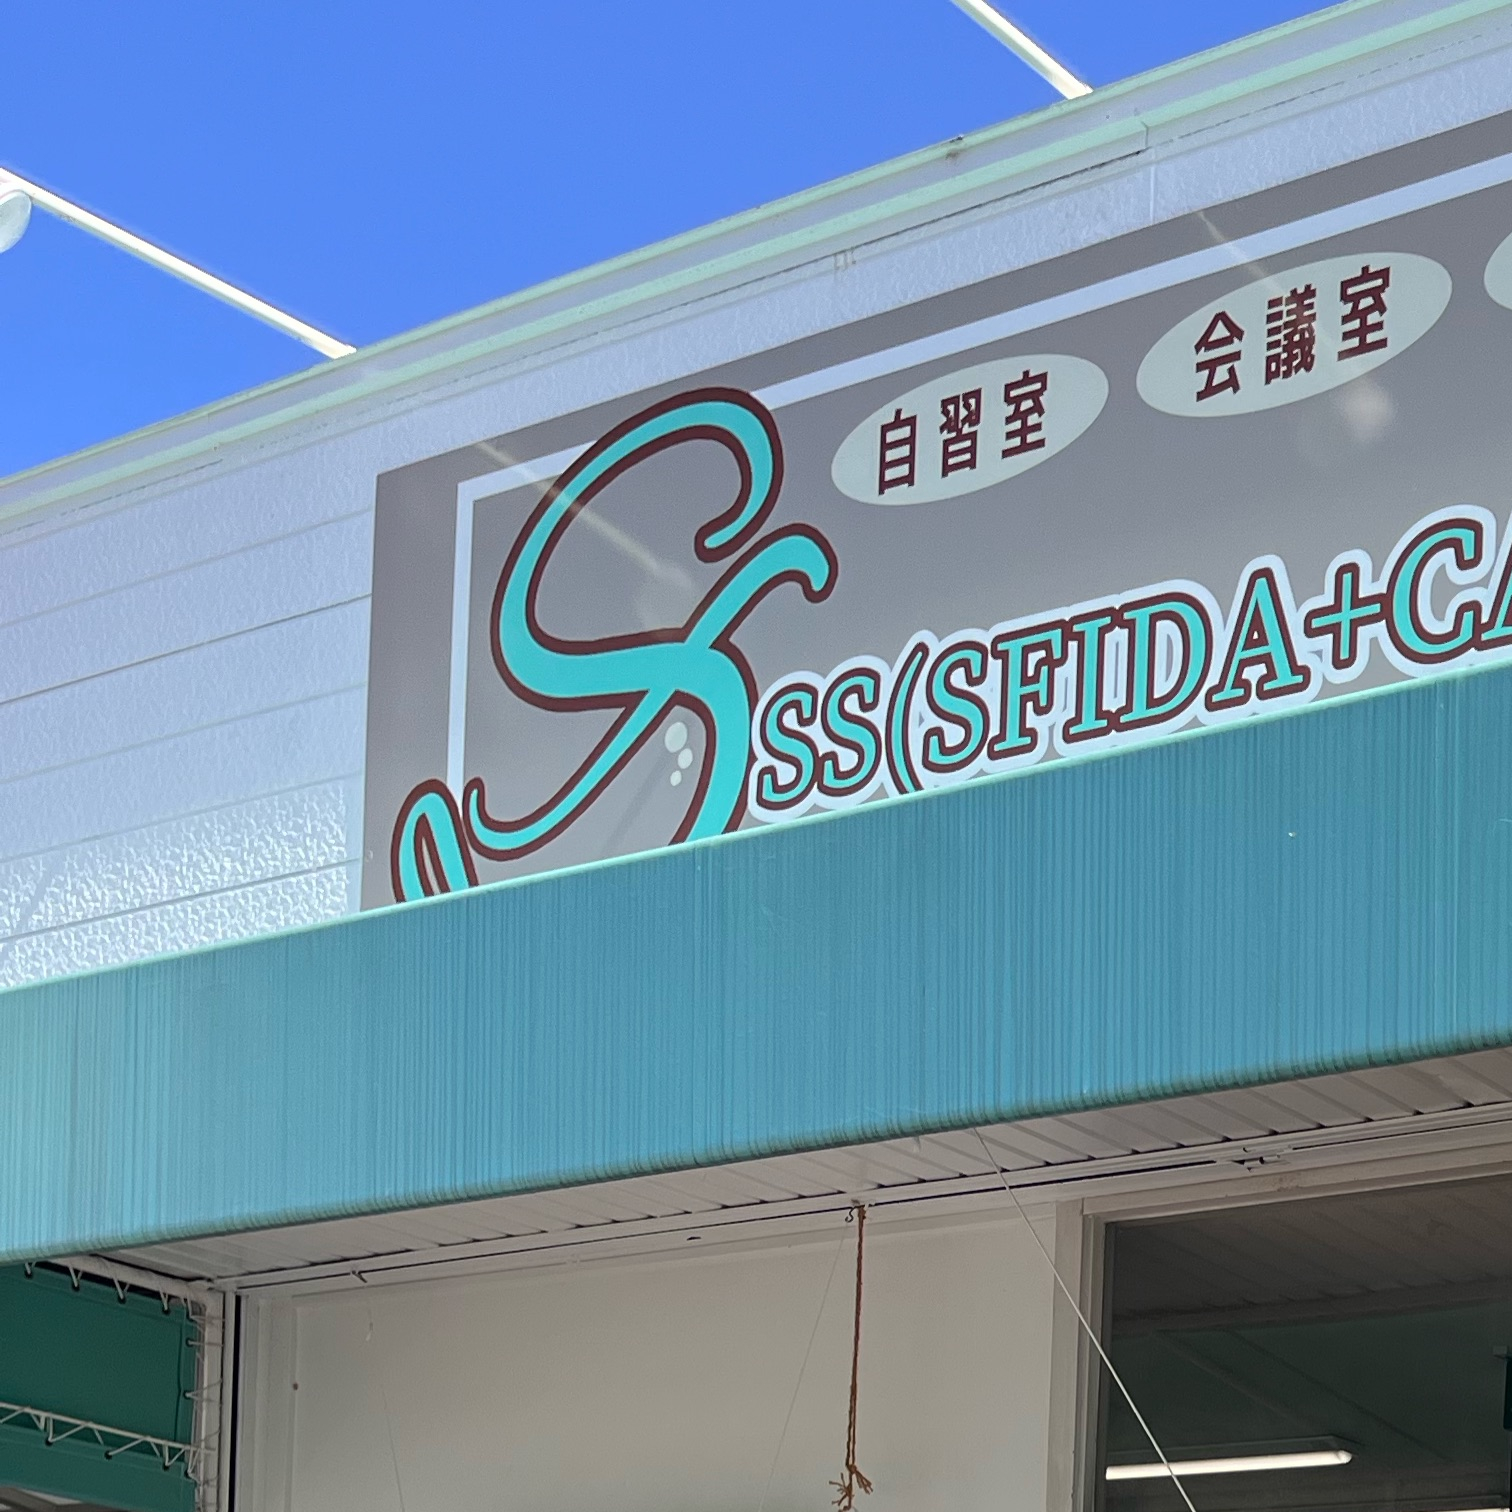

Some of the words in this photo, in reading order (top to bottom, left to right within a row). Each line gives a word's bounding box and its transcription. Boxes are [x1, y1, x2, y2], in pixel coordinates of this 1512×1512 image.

[1194, 264, 1391, 402] 会議室
[877, 370, 1048, 496] 自習室
